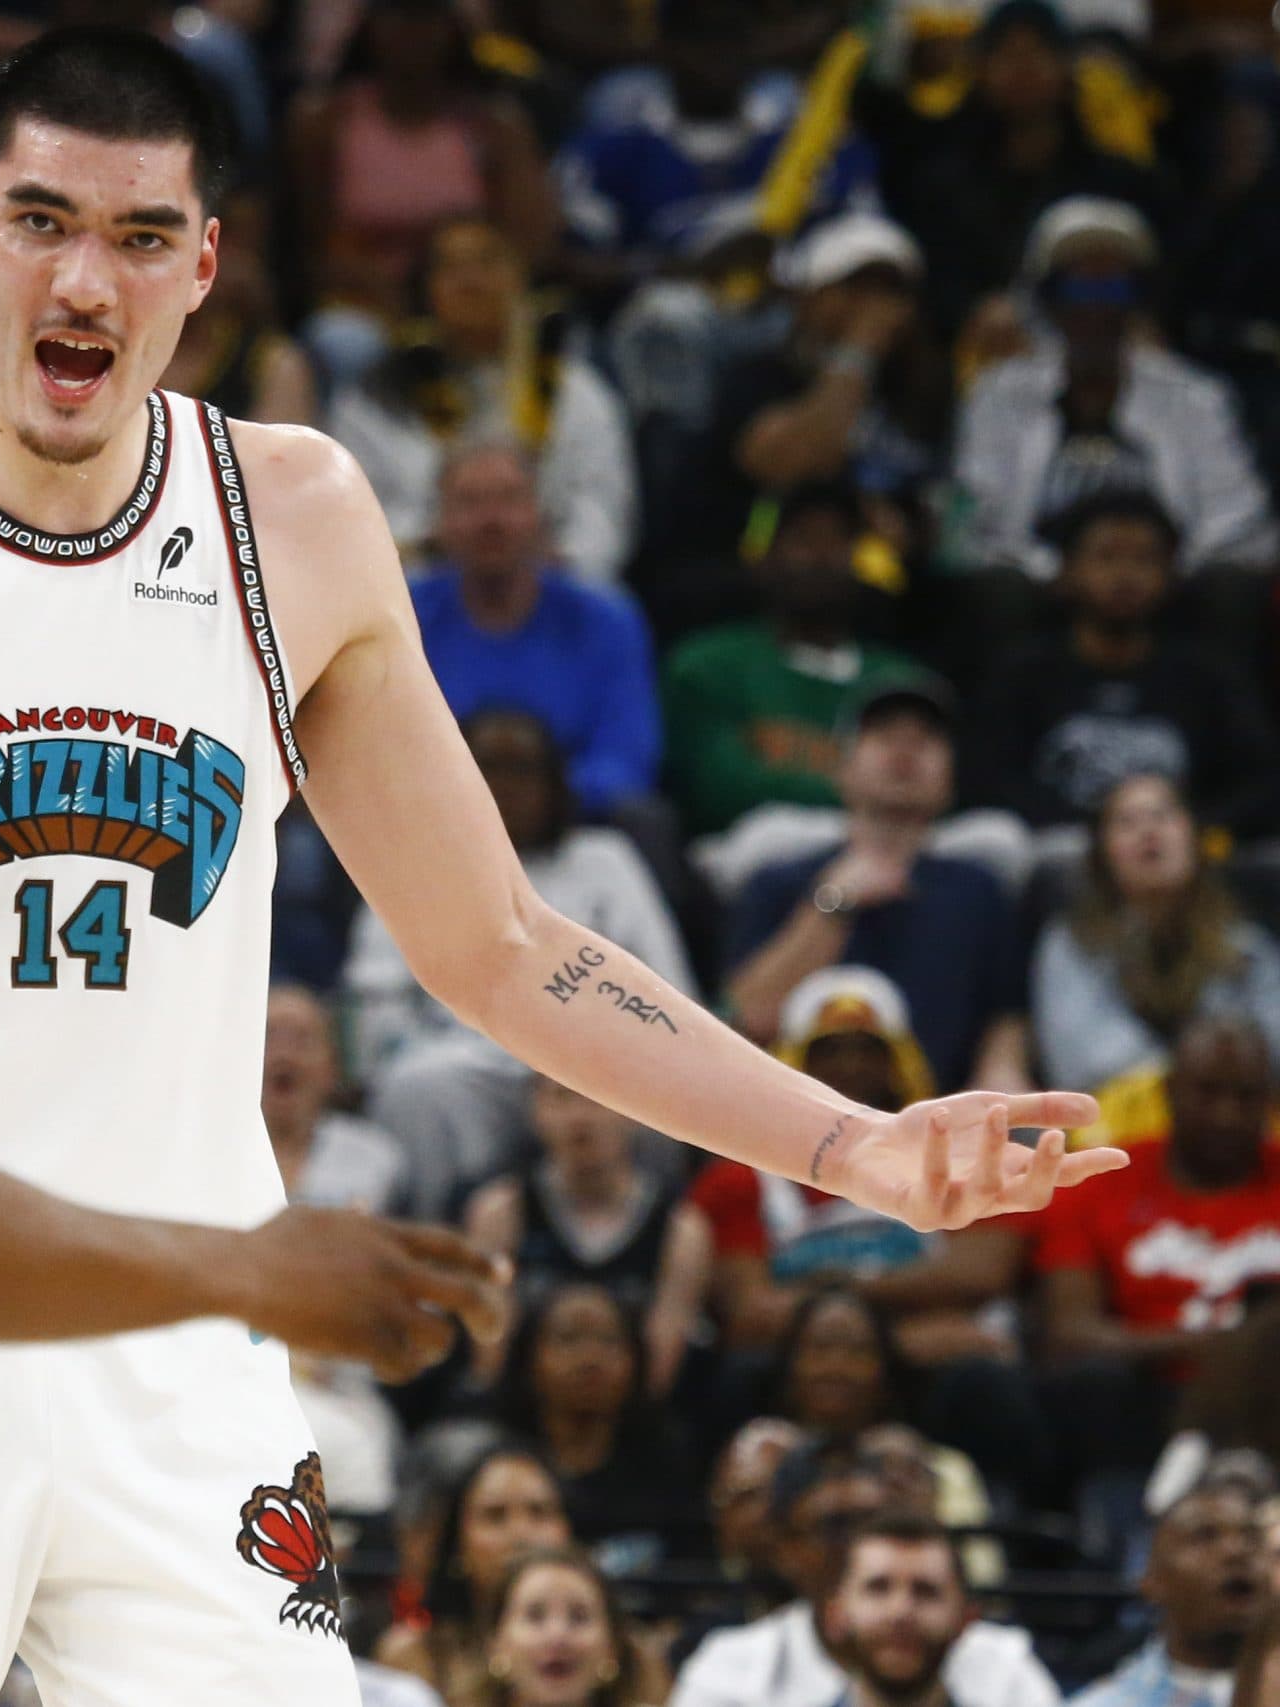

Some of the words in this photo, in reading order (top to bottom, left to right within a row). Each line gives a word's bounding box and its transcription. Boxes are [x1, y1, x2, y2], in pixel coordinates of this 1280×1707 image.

[134, 582, 218, 606] Robinhood
[11, 879, 132, 991] 14
[544, 946, 605, 1004] M4G
[597, 981, 678, 1035] 3R7
